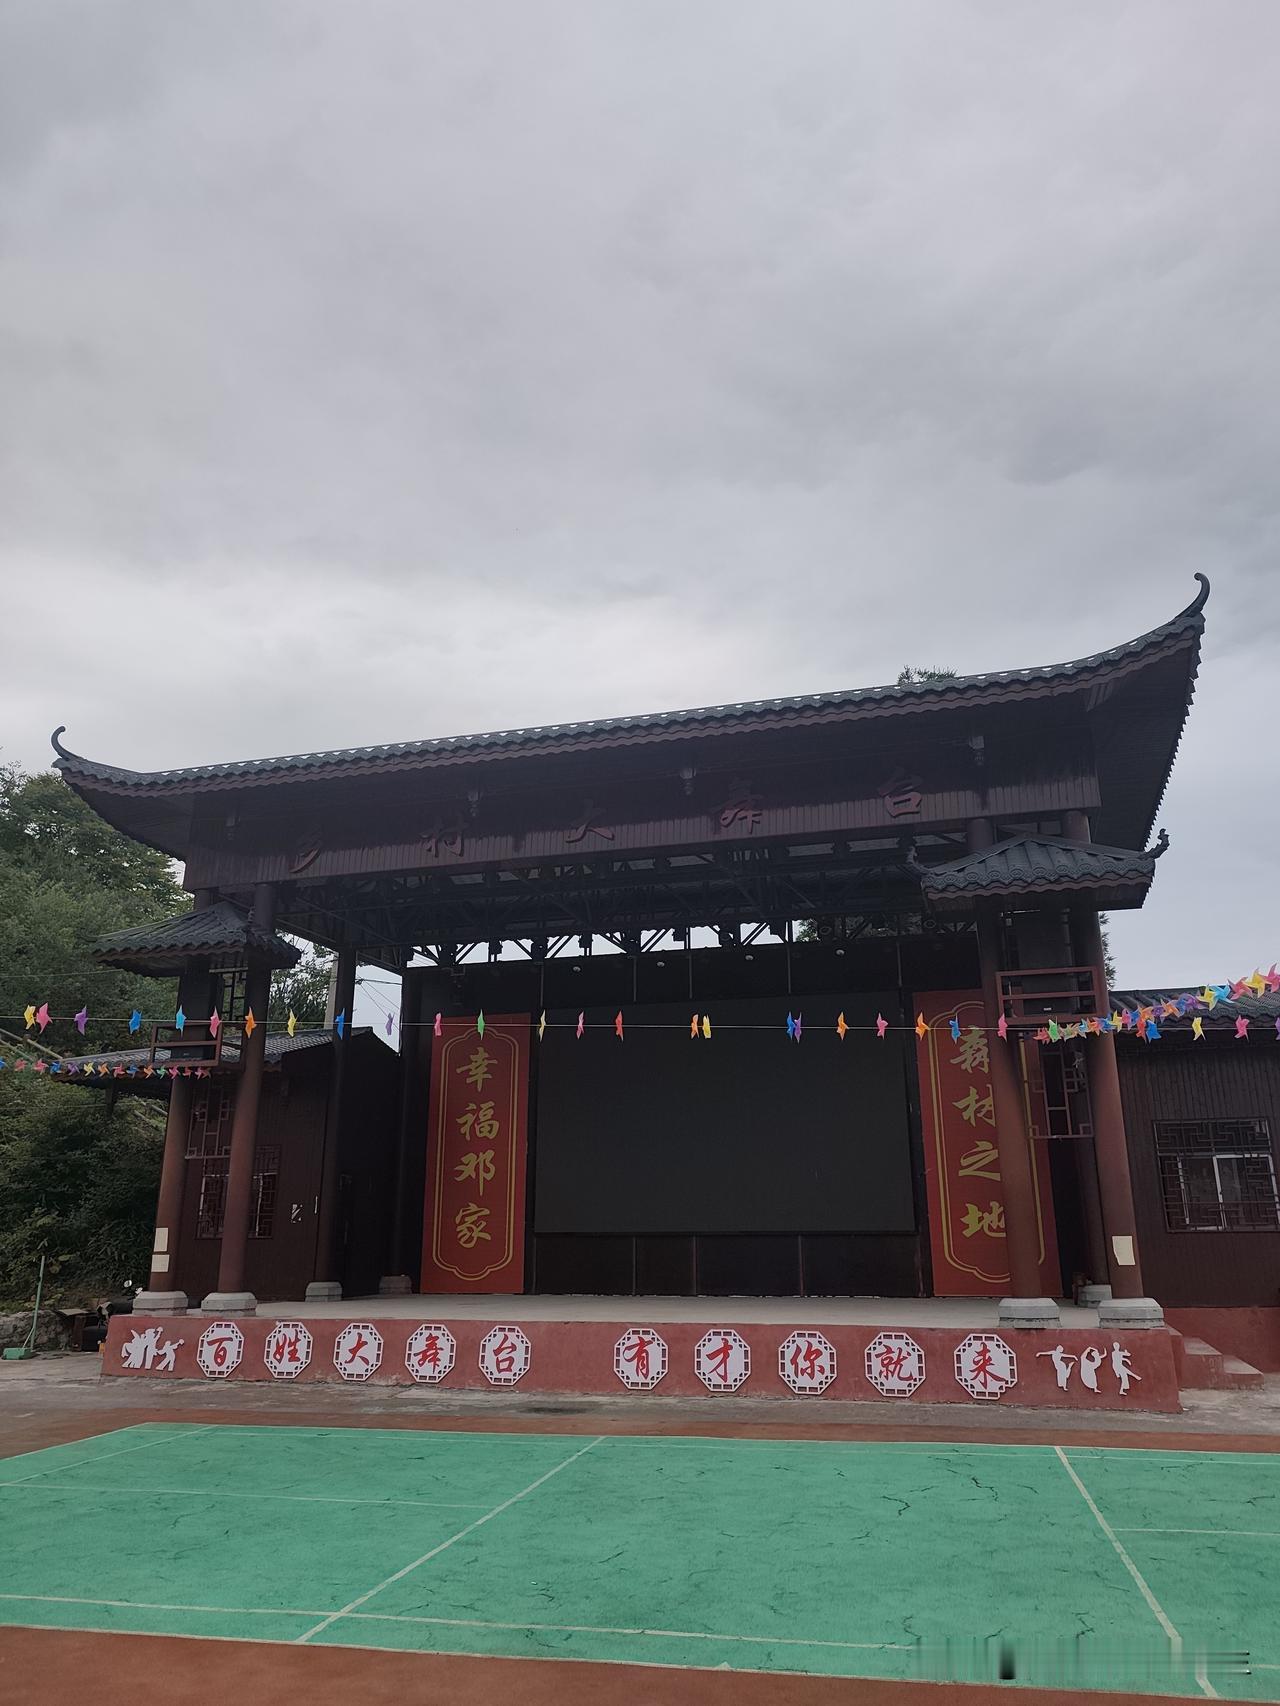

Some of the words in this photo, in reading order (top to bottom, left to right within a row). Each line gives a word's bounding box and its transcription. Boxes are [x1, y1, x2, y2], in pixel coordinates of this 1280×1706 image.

[454, 1046, 500, 1249] 幸福邓家
[206, 1332, 517, 1375] 百姓大舞台
[622, 1335, 1008, 1390] 有才你就来
